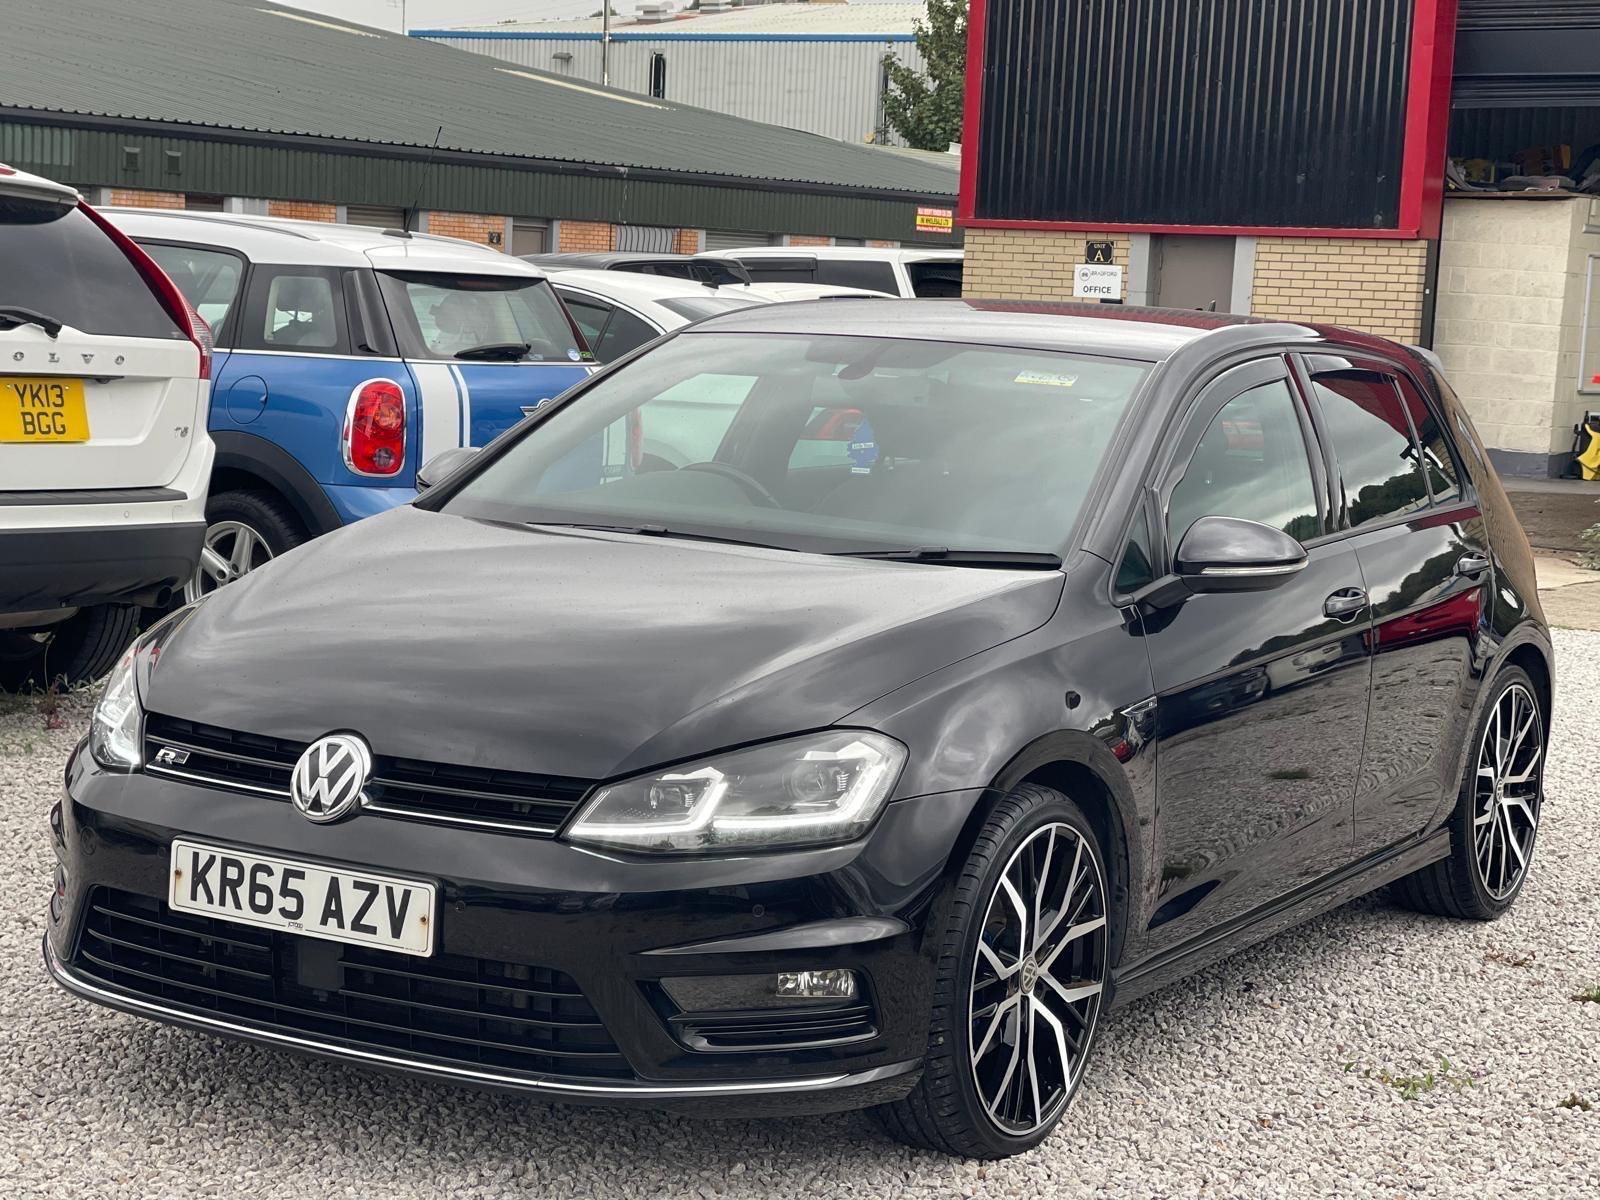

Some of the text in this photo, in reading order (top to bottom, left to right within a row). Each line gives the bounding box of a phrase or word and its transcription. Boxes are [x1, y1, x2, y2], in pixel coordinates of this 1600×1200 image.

[1094, 249, 1104, 262] A
[1083, 285, 1112, 294] OFFICE
[13, 351, 125, 366] OLVO
[14, 383, 65, 408] YK13
[21, 412, 67, 435] BGG
[190, 851, 412, 940] KR65 AZV
